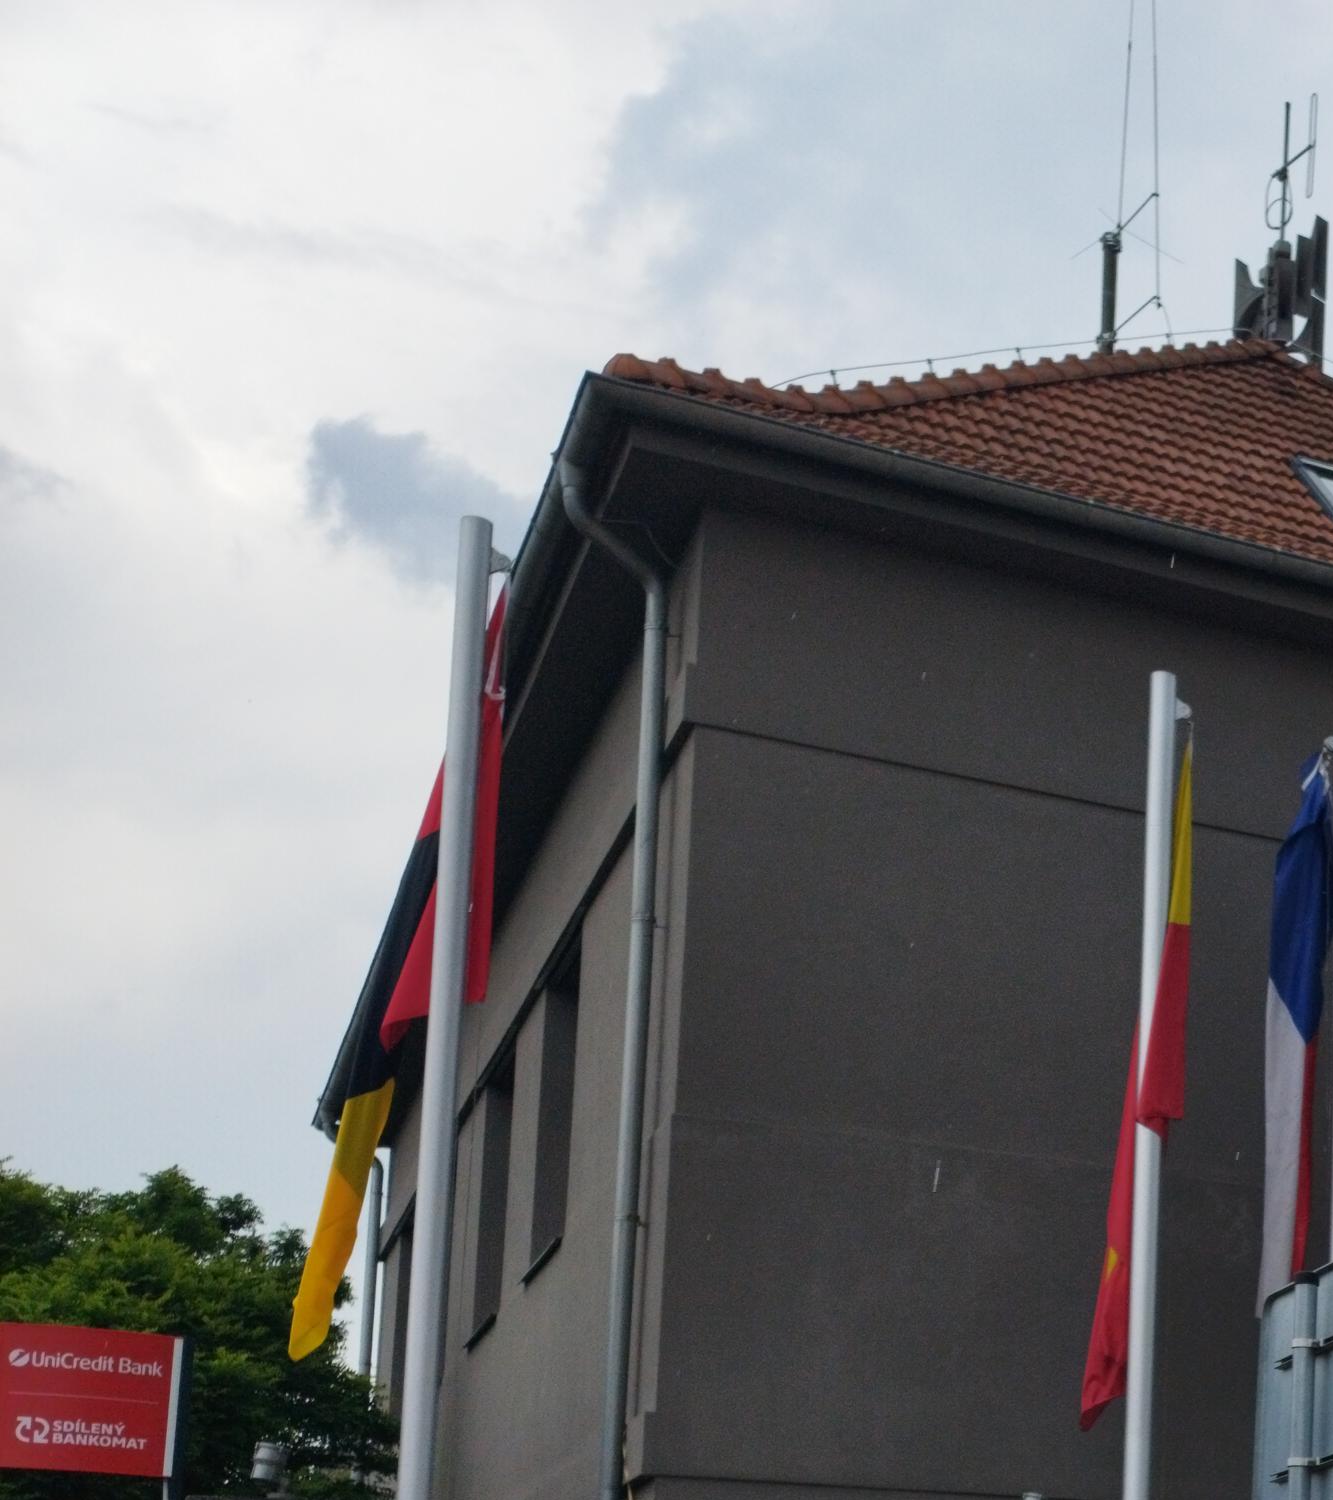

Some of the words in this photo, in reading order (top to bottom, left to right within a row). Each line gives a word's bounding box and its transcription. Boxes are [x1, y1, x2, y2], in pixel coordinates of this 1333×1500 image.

[31, 1351, 114, 1373] UniCredit
[118, 1357, 163, 1378] Bank
[52, 1417, 126, 1436] SDÍLENÝ
[52, 1433, 147, 1450] BANKOMAT
